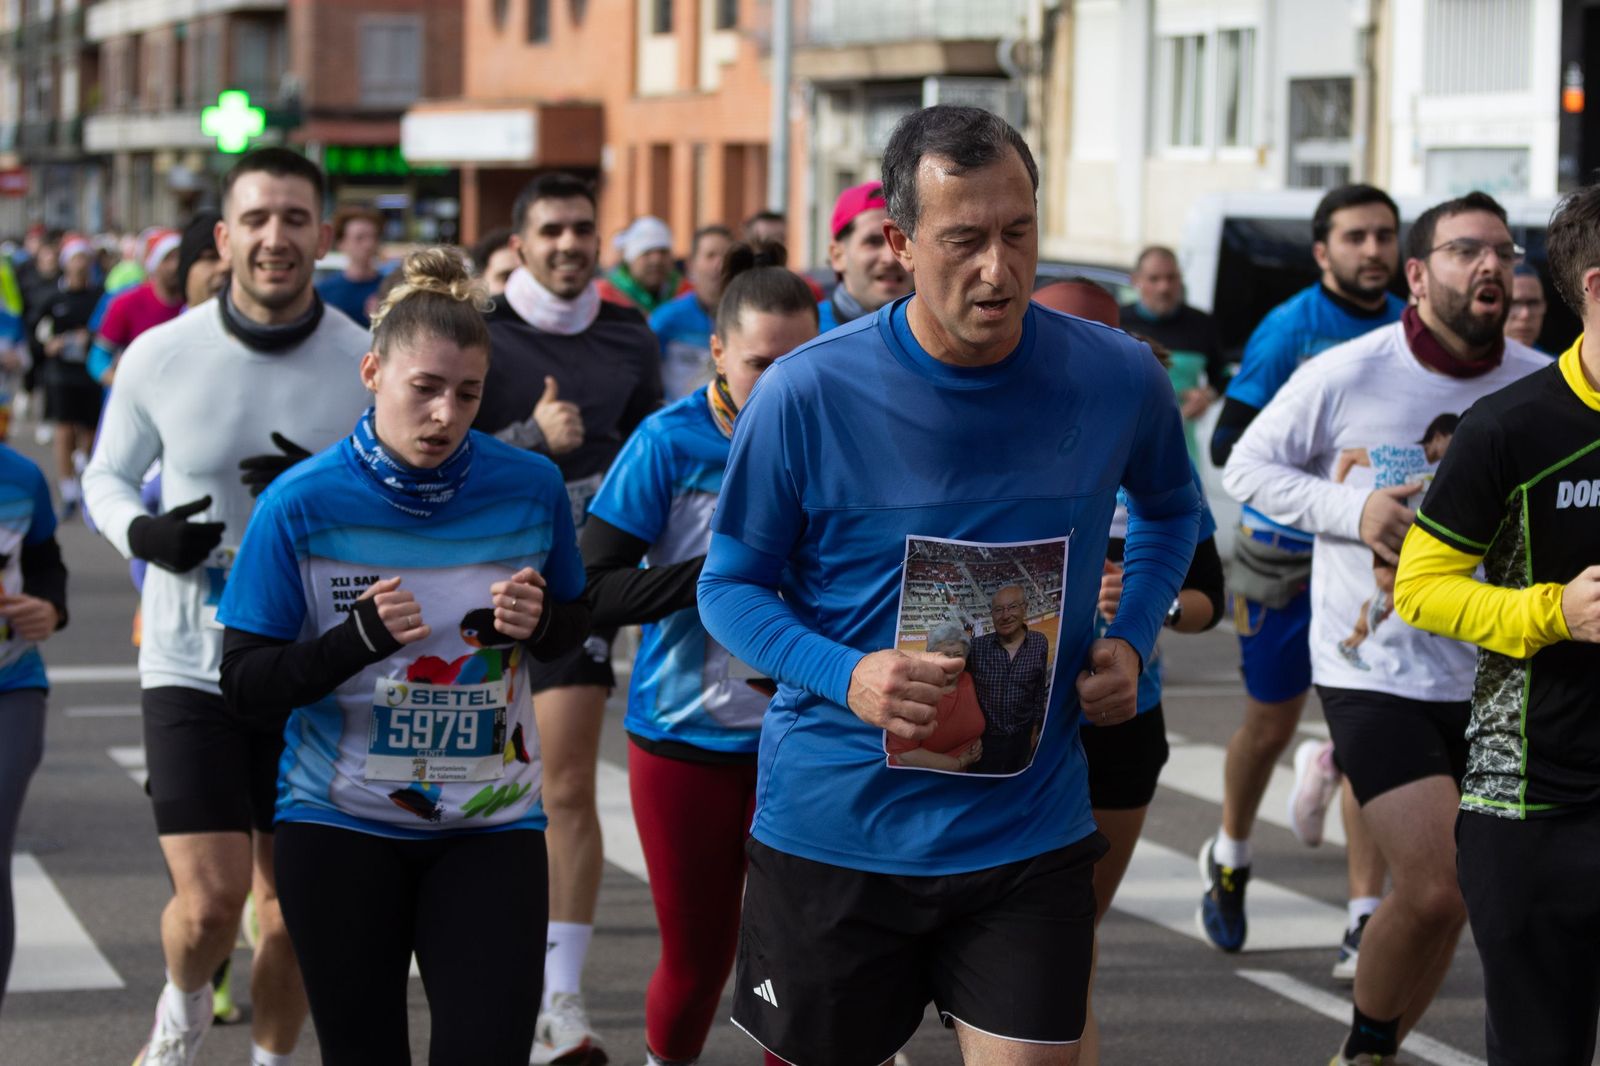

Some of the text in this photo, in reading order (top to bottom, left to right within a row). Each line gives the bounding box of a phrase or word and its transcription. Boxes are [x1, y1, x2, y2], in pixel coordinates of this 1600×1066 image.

[330, 576, 350, 587] XLI
[411, 689, 497, 706] SETEL
[388, 709, 479, 750] 5979
[429, 765, 467, 773] Ayuntamiento
